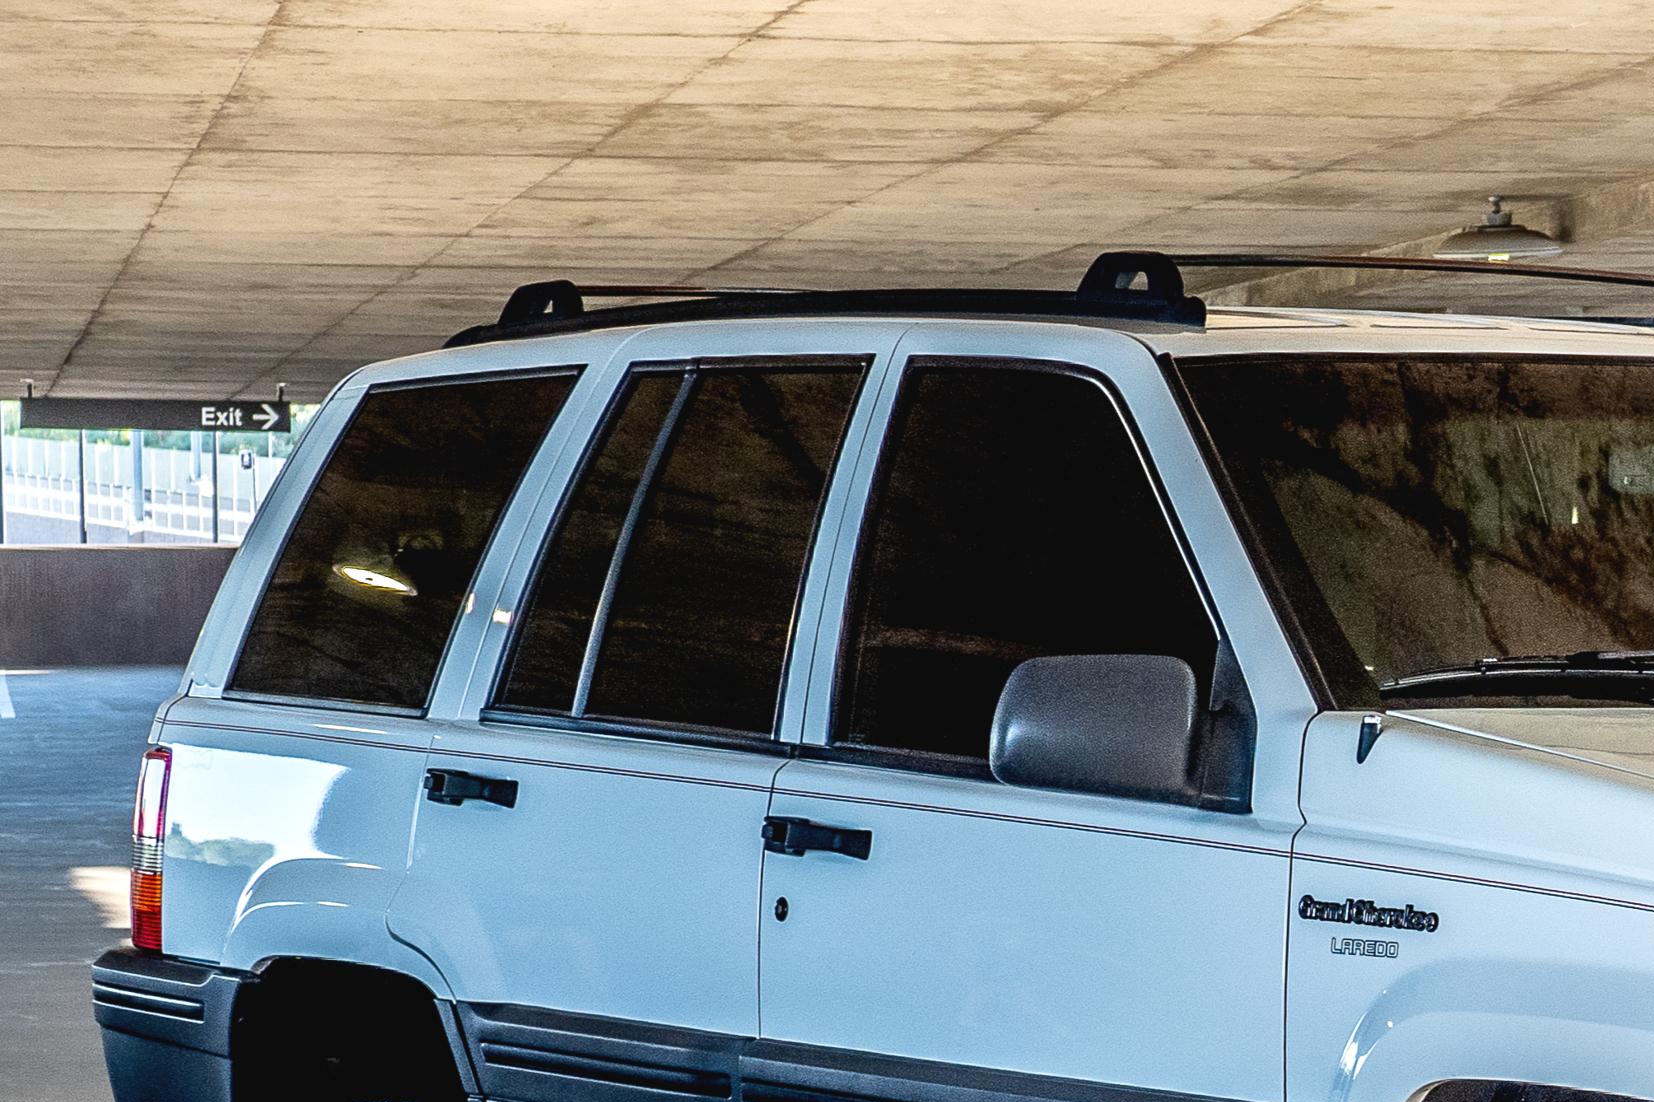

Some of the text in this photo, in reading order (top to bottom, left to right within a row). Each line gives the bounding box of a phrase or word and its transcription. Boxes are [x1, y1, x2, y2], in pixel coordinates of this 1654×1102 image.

[201, 406, 243, 427] Exit
[1298, 894, 1440, 933] Grand Cherokee
[1330, 936, 1400, 959] LAREDO
